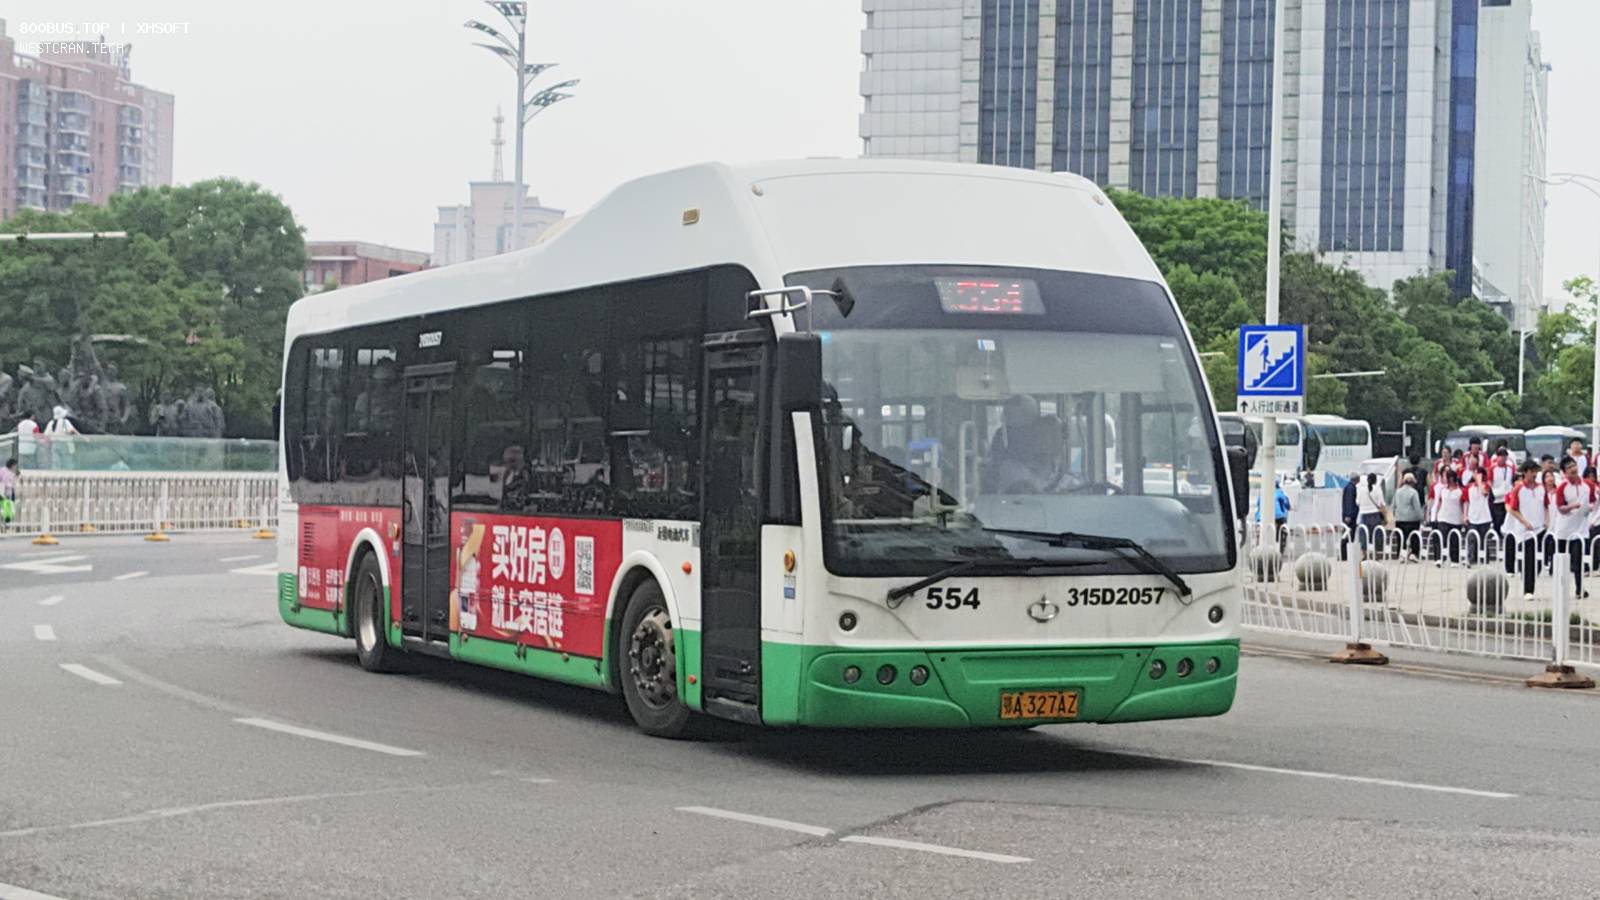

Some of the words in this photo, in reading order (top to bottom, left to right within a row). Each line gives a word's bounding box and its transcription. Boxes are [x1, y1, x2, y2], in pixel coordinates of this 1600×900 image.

[1250, 400, 1299, 413] 人行过街通道
[491, 524, 546, 585] 买好房
[925, 587, 981, 610] 554
[1067, 587, 1165, 607] 315D2057
